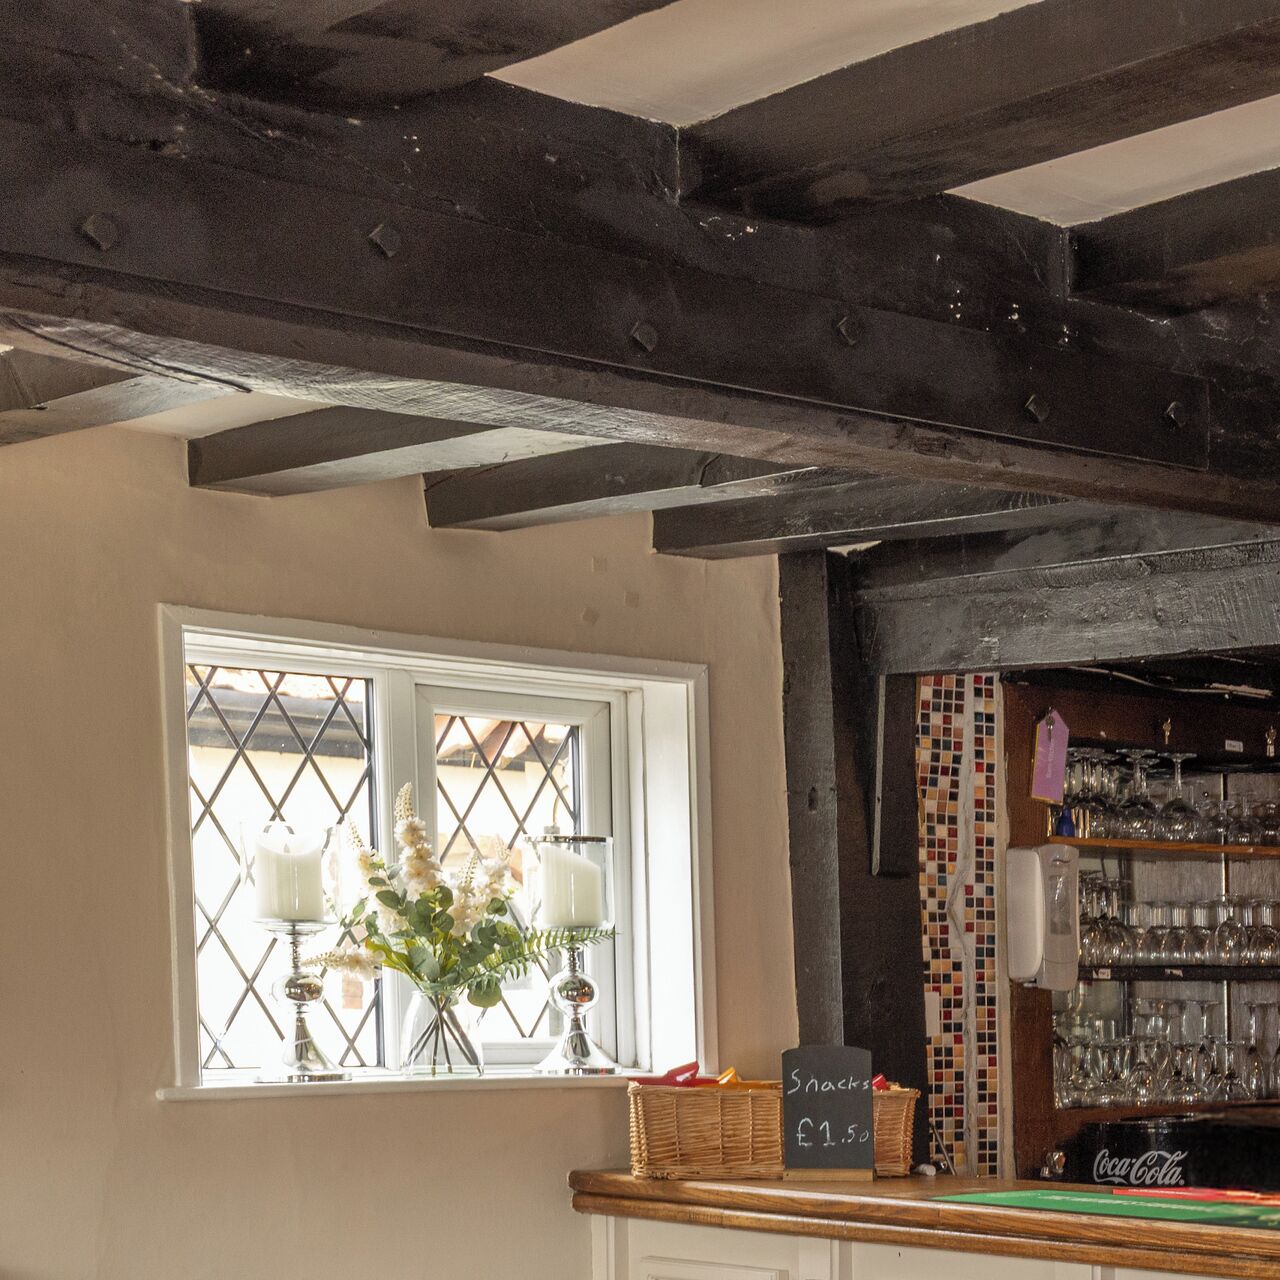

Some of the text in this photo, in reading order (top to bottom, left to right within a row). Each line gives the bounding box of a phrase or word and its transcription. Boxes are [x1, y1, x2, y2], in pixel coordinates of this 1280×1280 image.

[787, 1068, 870, 1095] Snacks
[796, 1117, 870, 1147] £1.50
[1093, 1149, 1189, 1185] Coca-Cola
